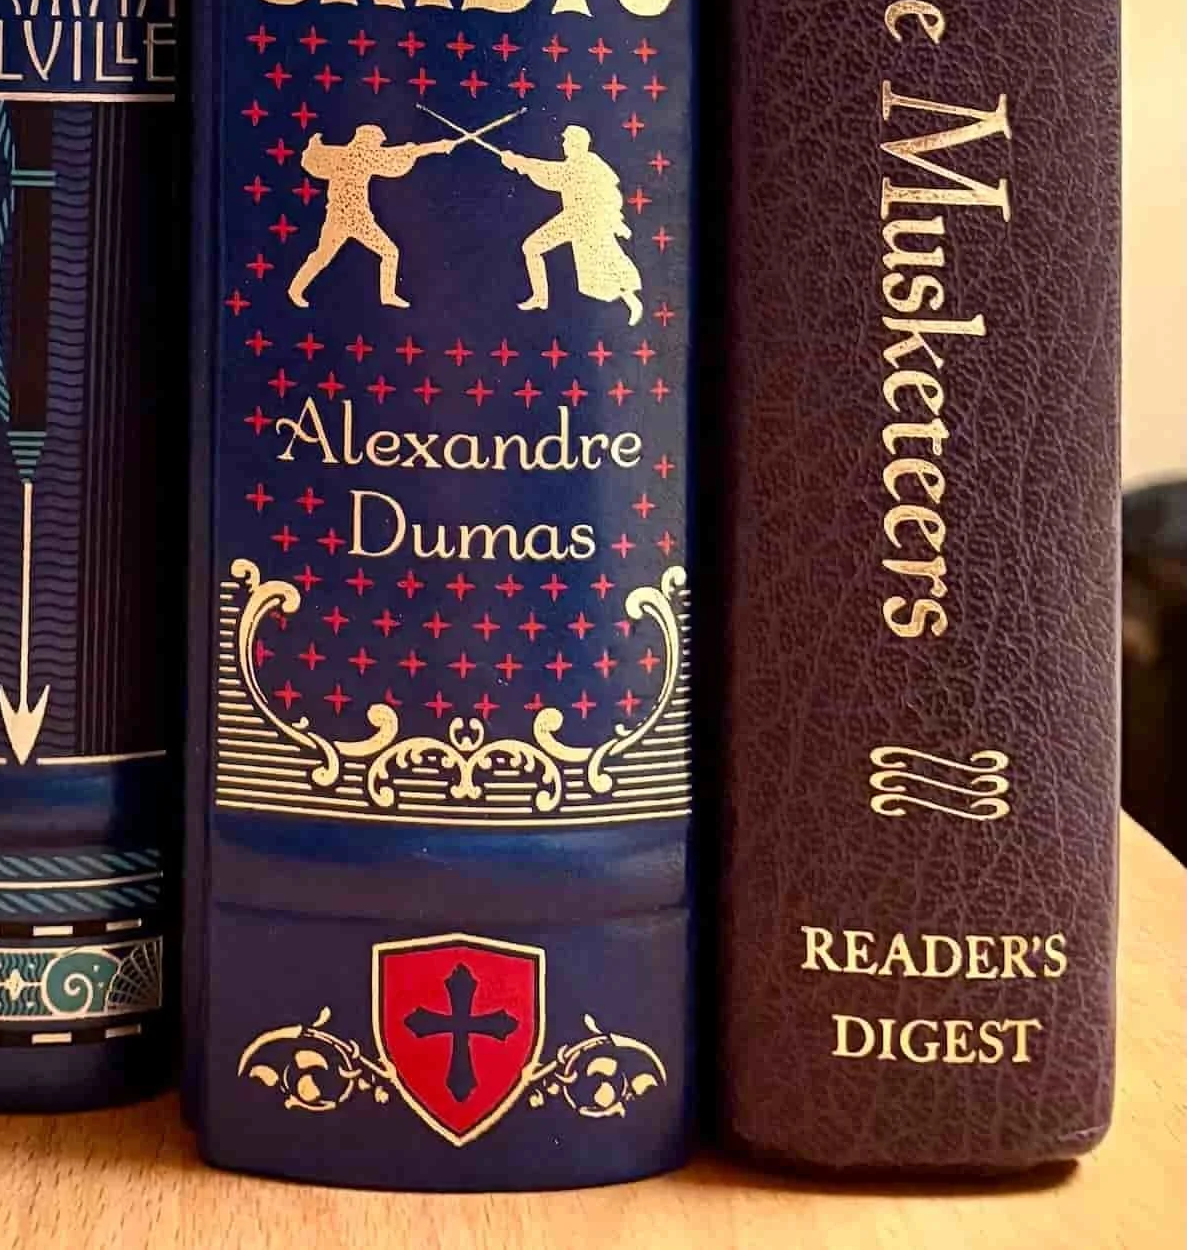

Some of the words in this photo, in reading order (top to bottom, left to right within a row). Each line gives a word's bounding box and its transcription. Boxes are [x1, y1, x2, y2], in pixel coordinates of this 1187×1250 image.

[880, 79, 1012, 638] Musketeers
[275, 396, 643, 470] Alexandre
[347, 489, 597, 559] Dumas
[801, 925, 1068, 979] READER'S
[832, 1014, 1043, 1064] DIGEST
